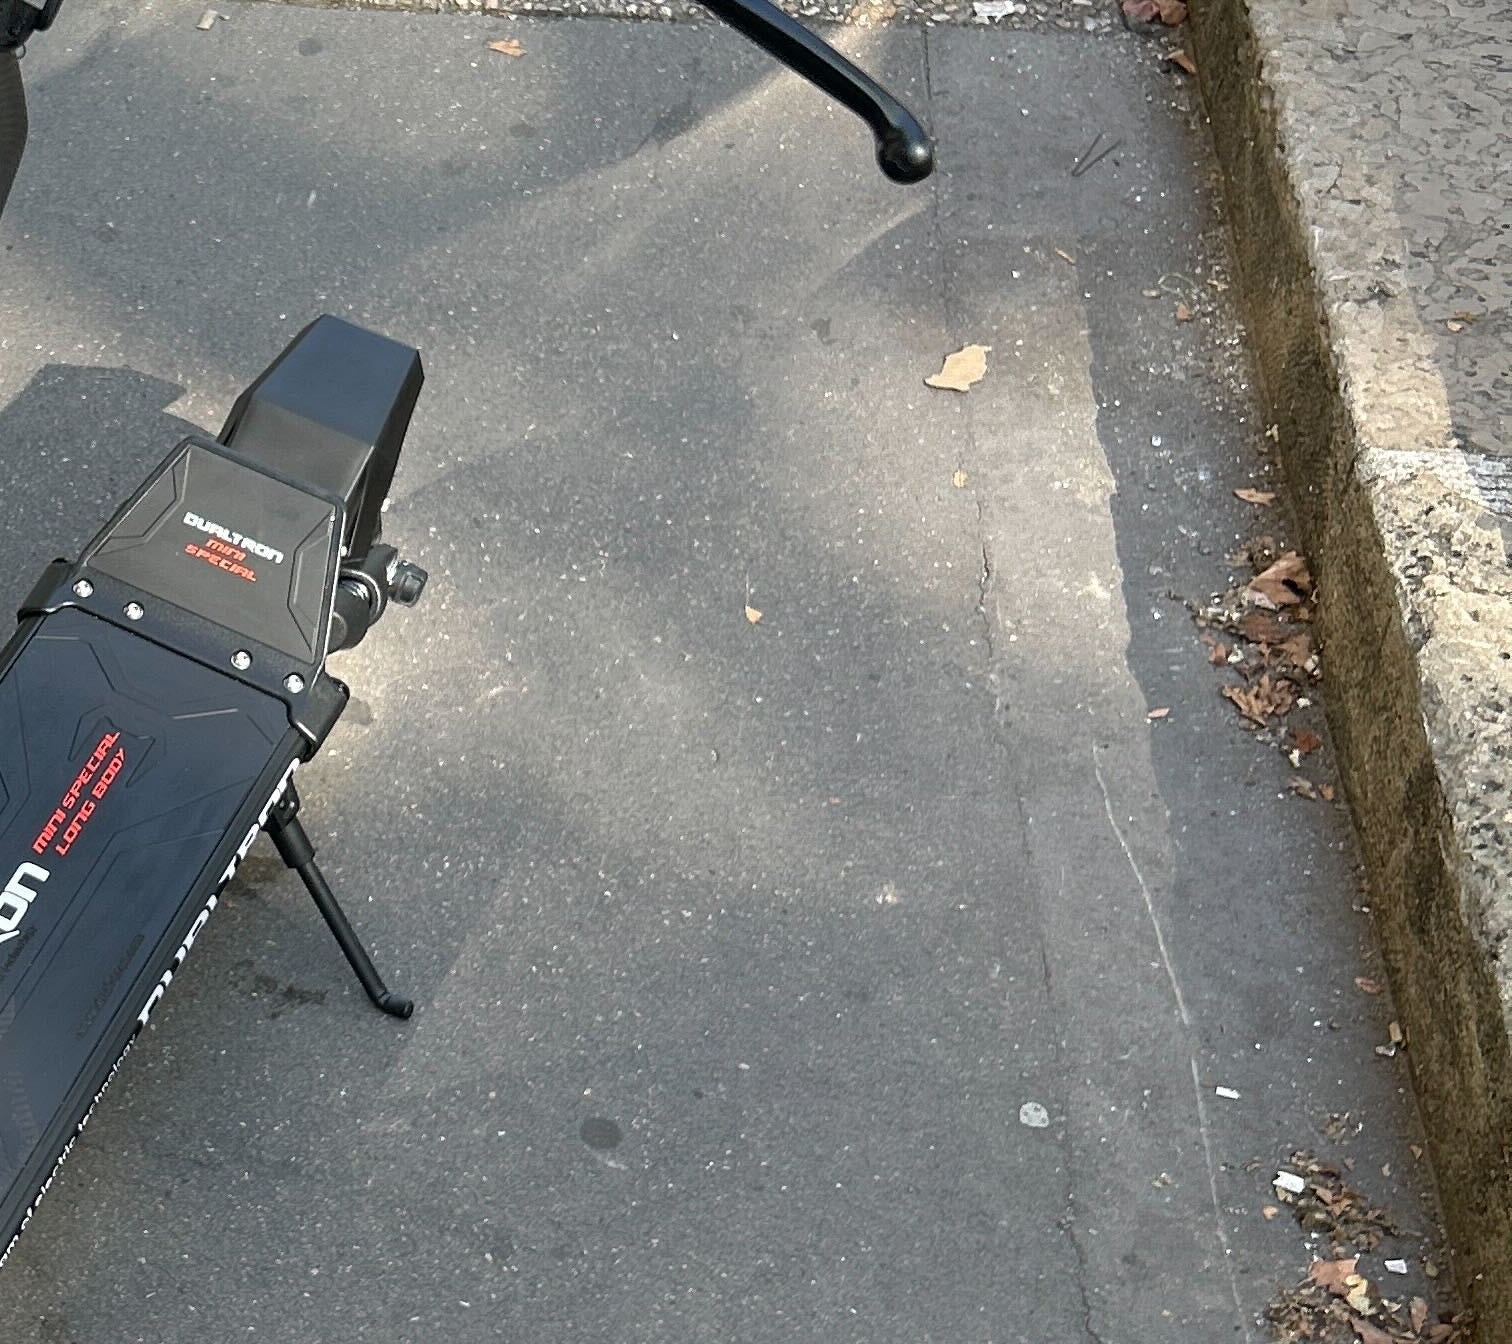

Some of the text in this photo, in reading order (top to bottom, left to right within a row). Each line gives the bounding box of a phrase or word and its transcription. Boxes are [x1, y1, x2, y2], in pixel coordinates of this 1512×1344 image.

[183, 511, 284, 564] DUALTRON
[185, 544, 257, 582] SPECIAL
[55, 746, 126, 856] LONG BODY
[61, 731, 121, 809] SPECIAL
